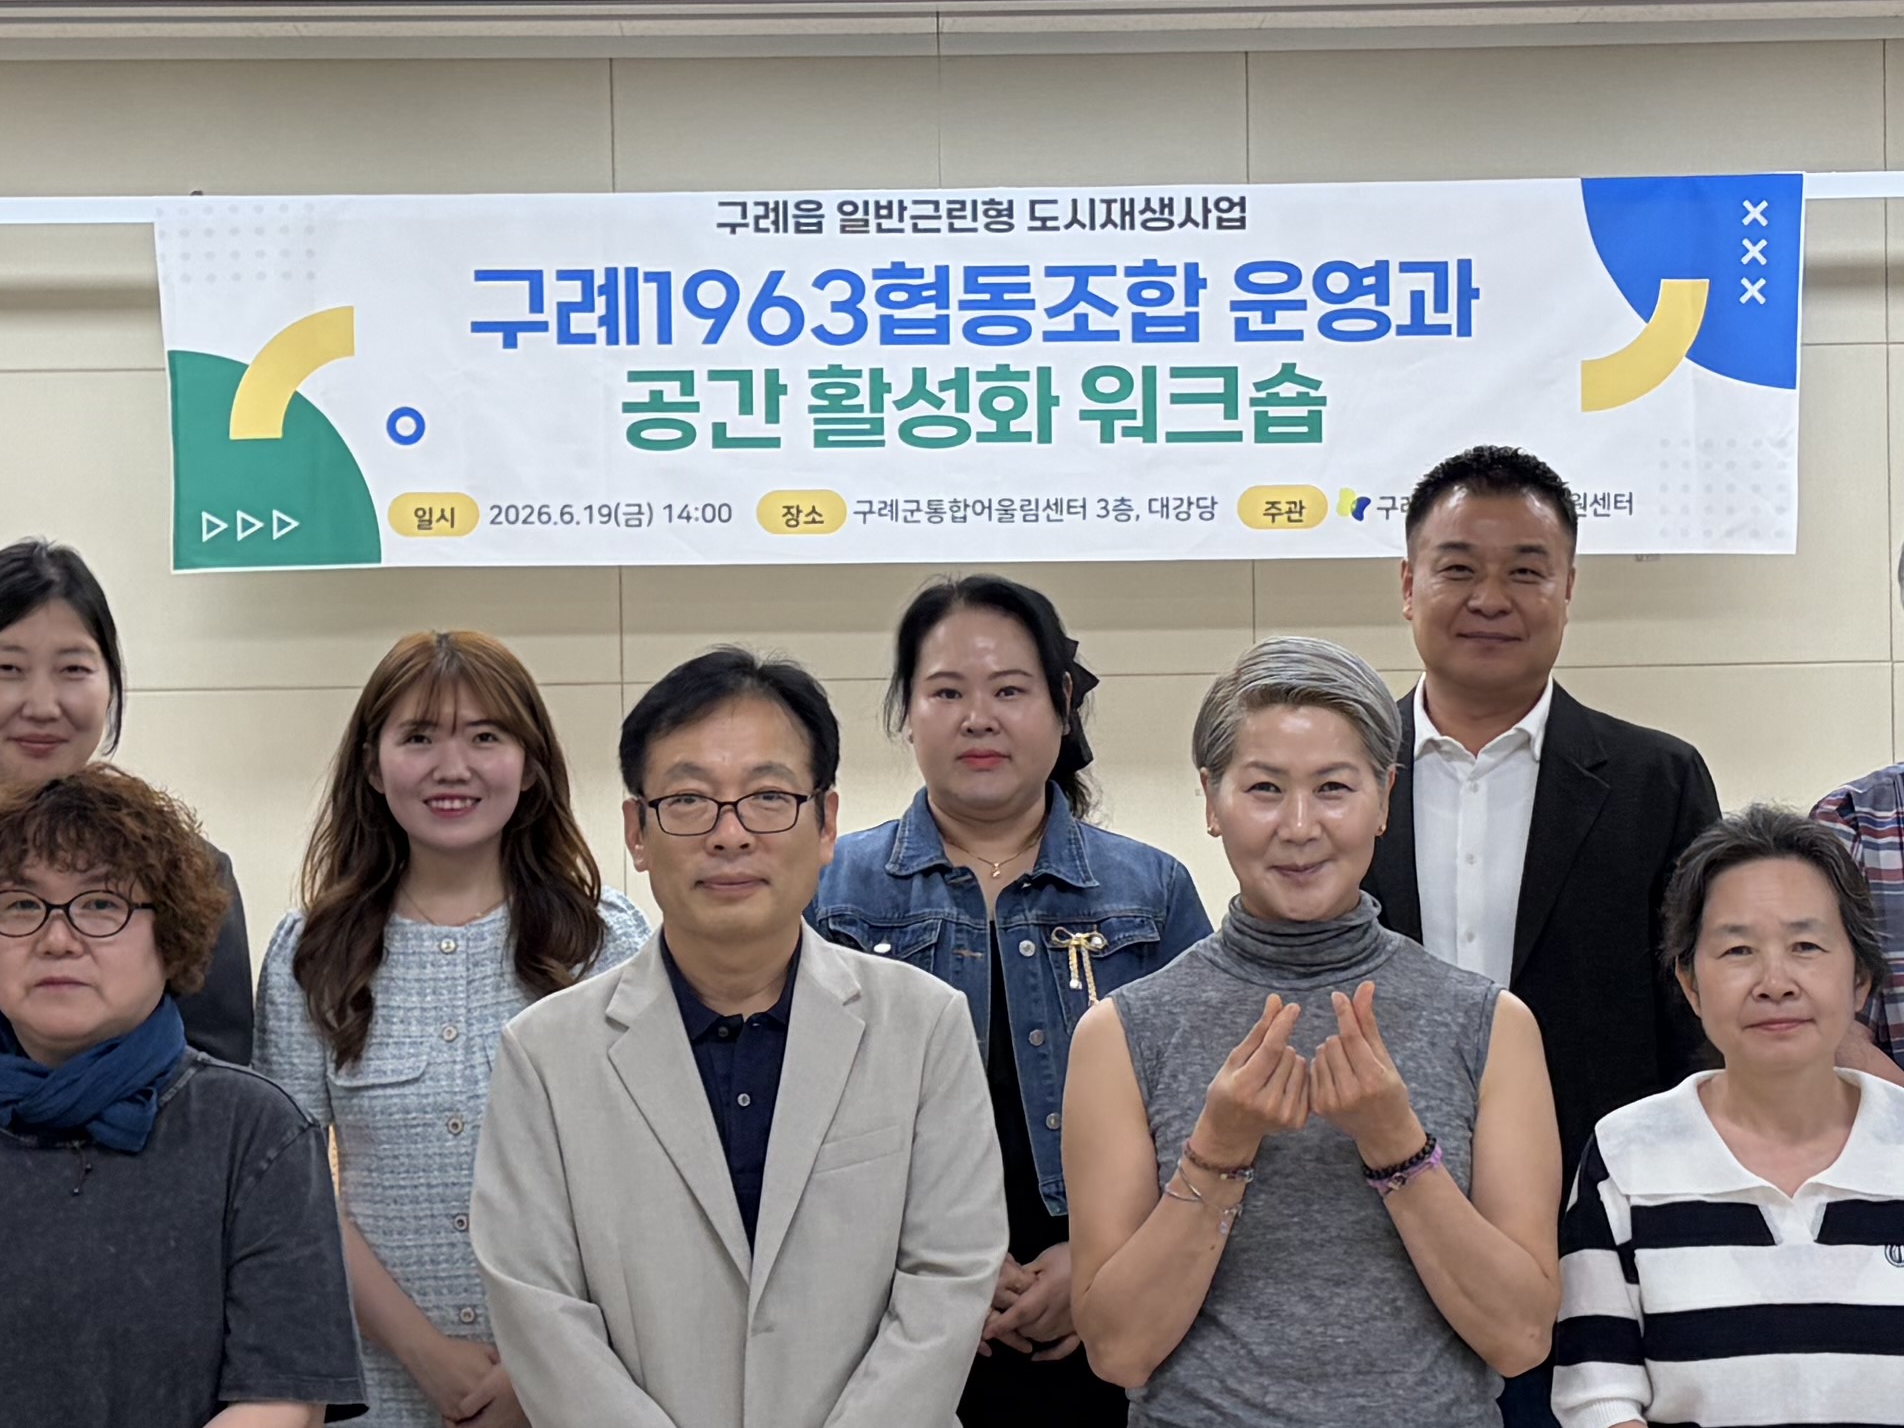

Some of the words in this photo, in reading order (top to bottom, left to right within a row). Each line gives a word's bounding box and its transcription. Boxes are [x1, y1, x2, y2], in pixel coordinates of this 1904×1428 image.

[716, 199, 826, 235] 구례읍
[836, 197, 1015, 235] 일반근린형
[1027, 195, 1247, 232] 도시재생사업
[470, 258, 1208, 350] 구례1963협동조합
[1229, 258, 1481, 343] 운영과
[621, 368, 788, 452] 공간
[807, 363, 1061, 450] 활성화
[1078, 362, 1328, 444] 워크숍
[413, 506, 455, 531] 일시
[489, 501, 654, 528] 2026.6.19(금)
[662, 502, 733, 524] 14:00
[781, 504, 825, 528] 장소
[852, 496, 1087, 525] 구례군통합어울림센터
[1096, 496, 1140, 523] 3층,
[1147, 495, 1219, 522] 대강당
[1262, 499, 1306, 524] 주관
